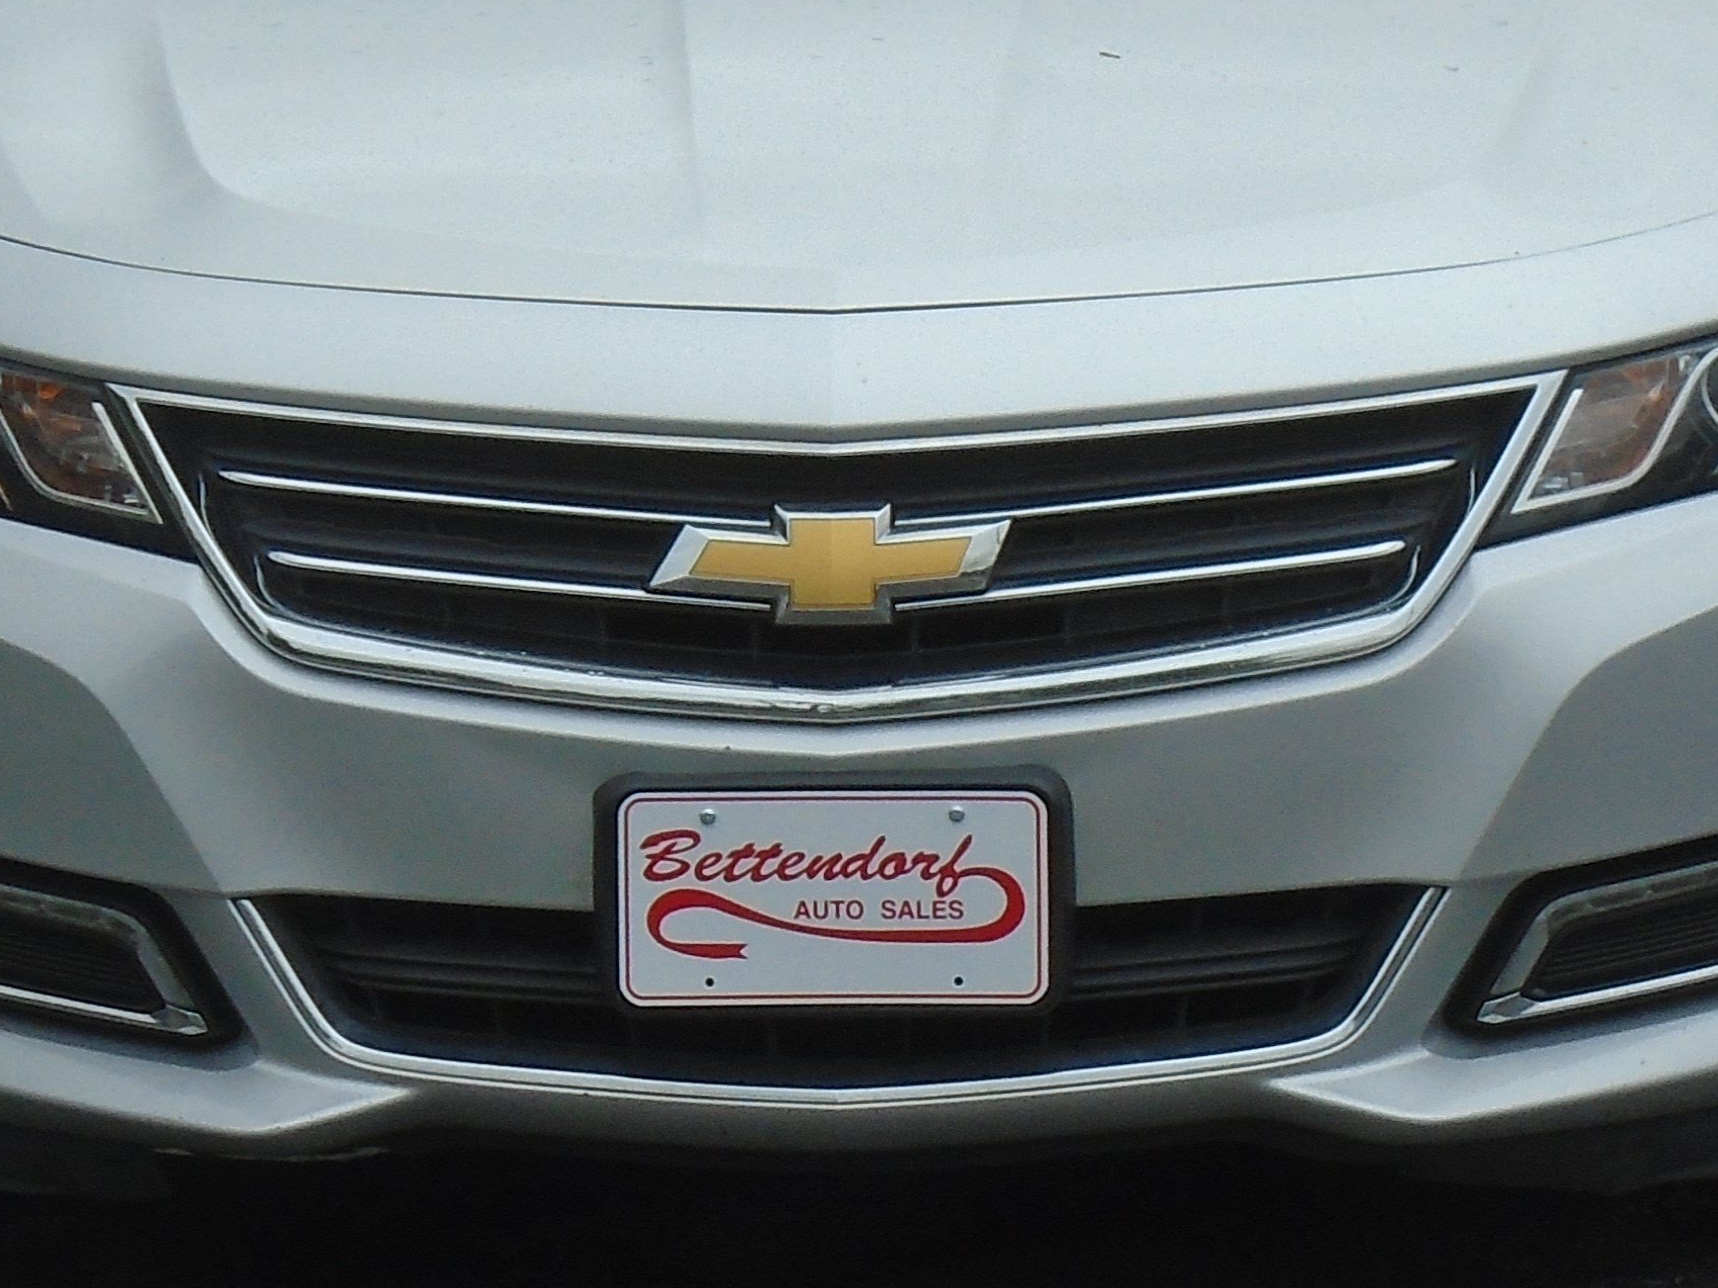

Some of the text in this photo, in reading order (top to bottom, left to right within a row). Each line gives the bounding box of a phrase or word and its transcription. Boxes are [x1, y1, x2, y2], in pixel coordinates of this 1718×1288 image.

[640, 829, 973, 898] Bettendorf
[793, 899, 965, 920] AUTO SALES
